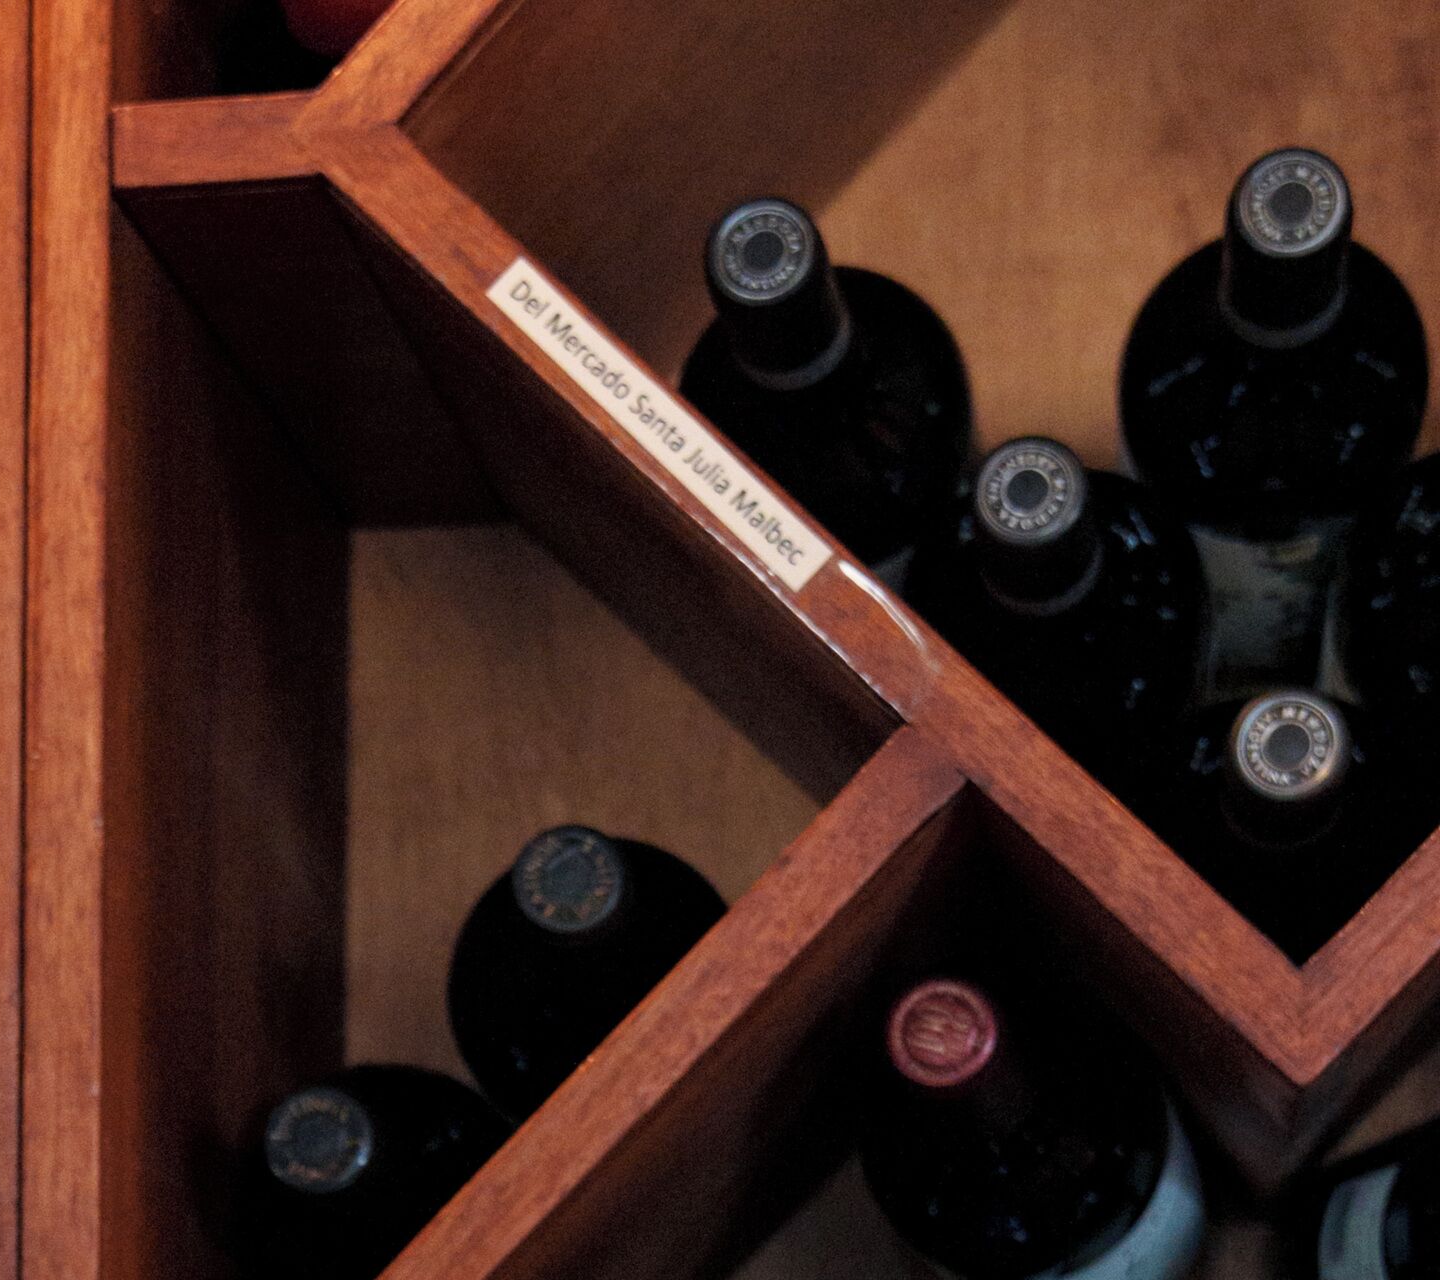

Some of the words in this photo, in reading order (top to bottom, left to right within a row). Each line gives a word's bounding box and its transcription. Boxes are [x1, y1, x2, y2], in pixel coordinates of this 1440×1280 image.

[510, 279, 549, 320] Del
[545, 312, 631, 400] Mercado
[628, 393, 687, 453] Santa
[682, 448, 730, 495] Julia
[729, 489, 806, 566] Malbec
